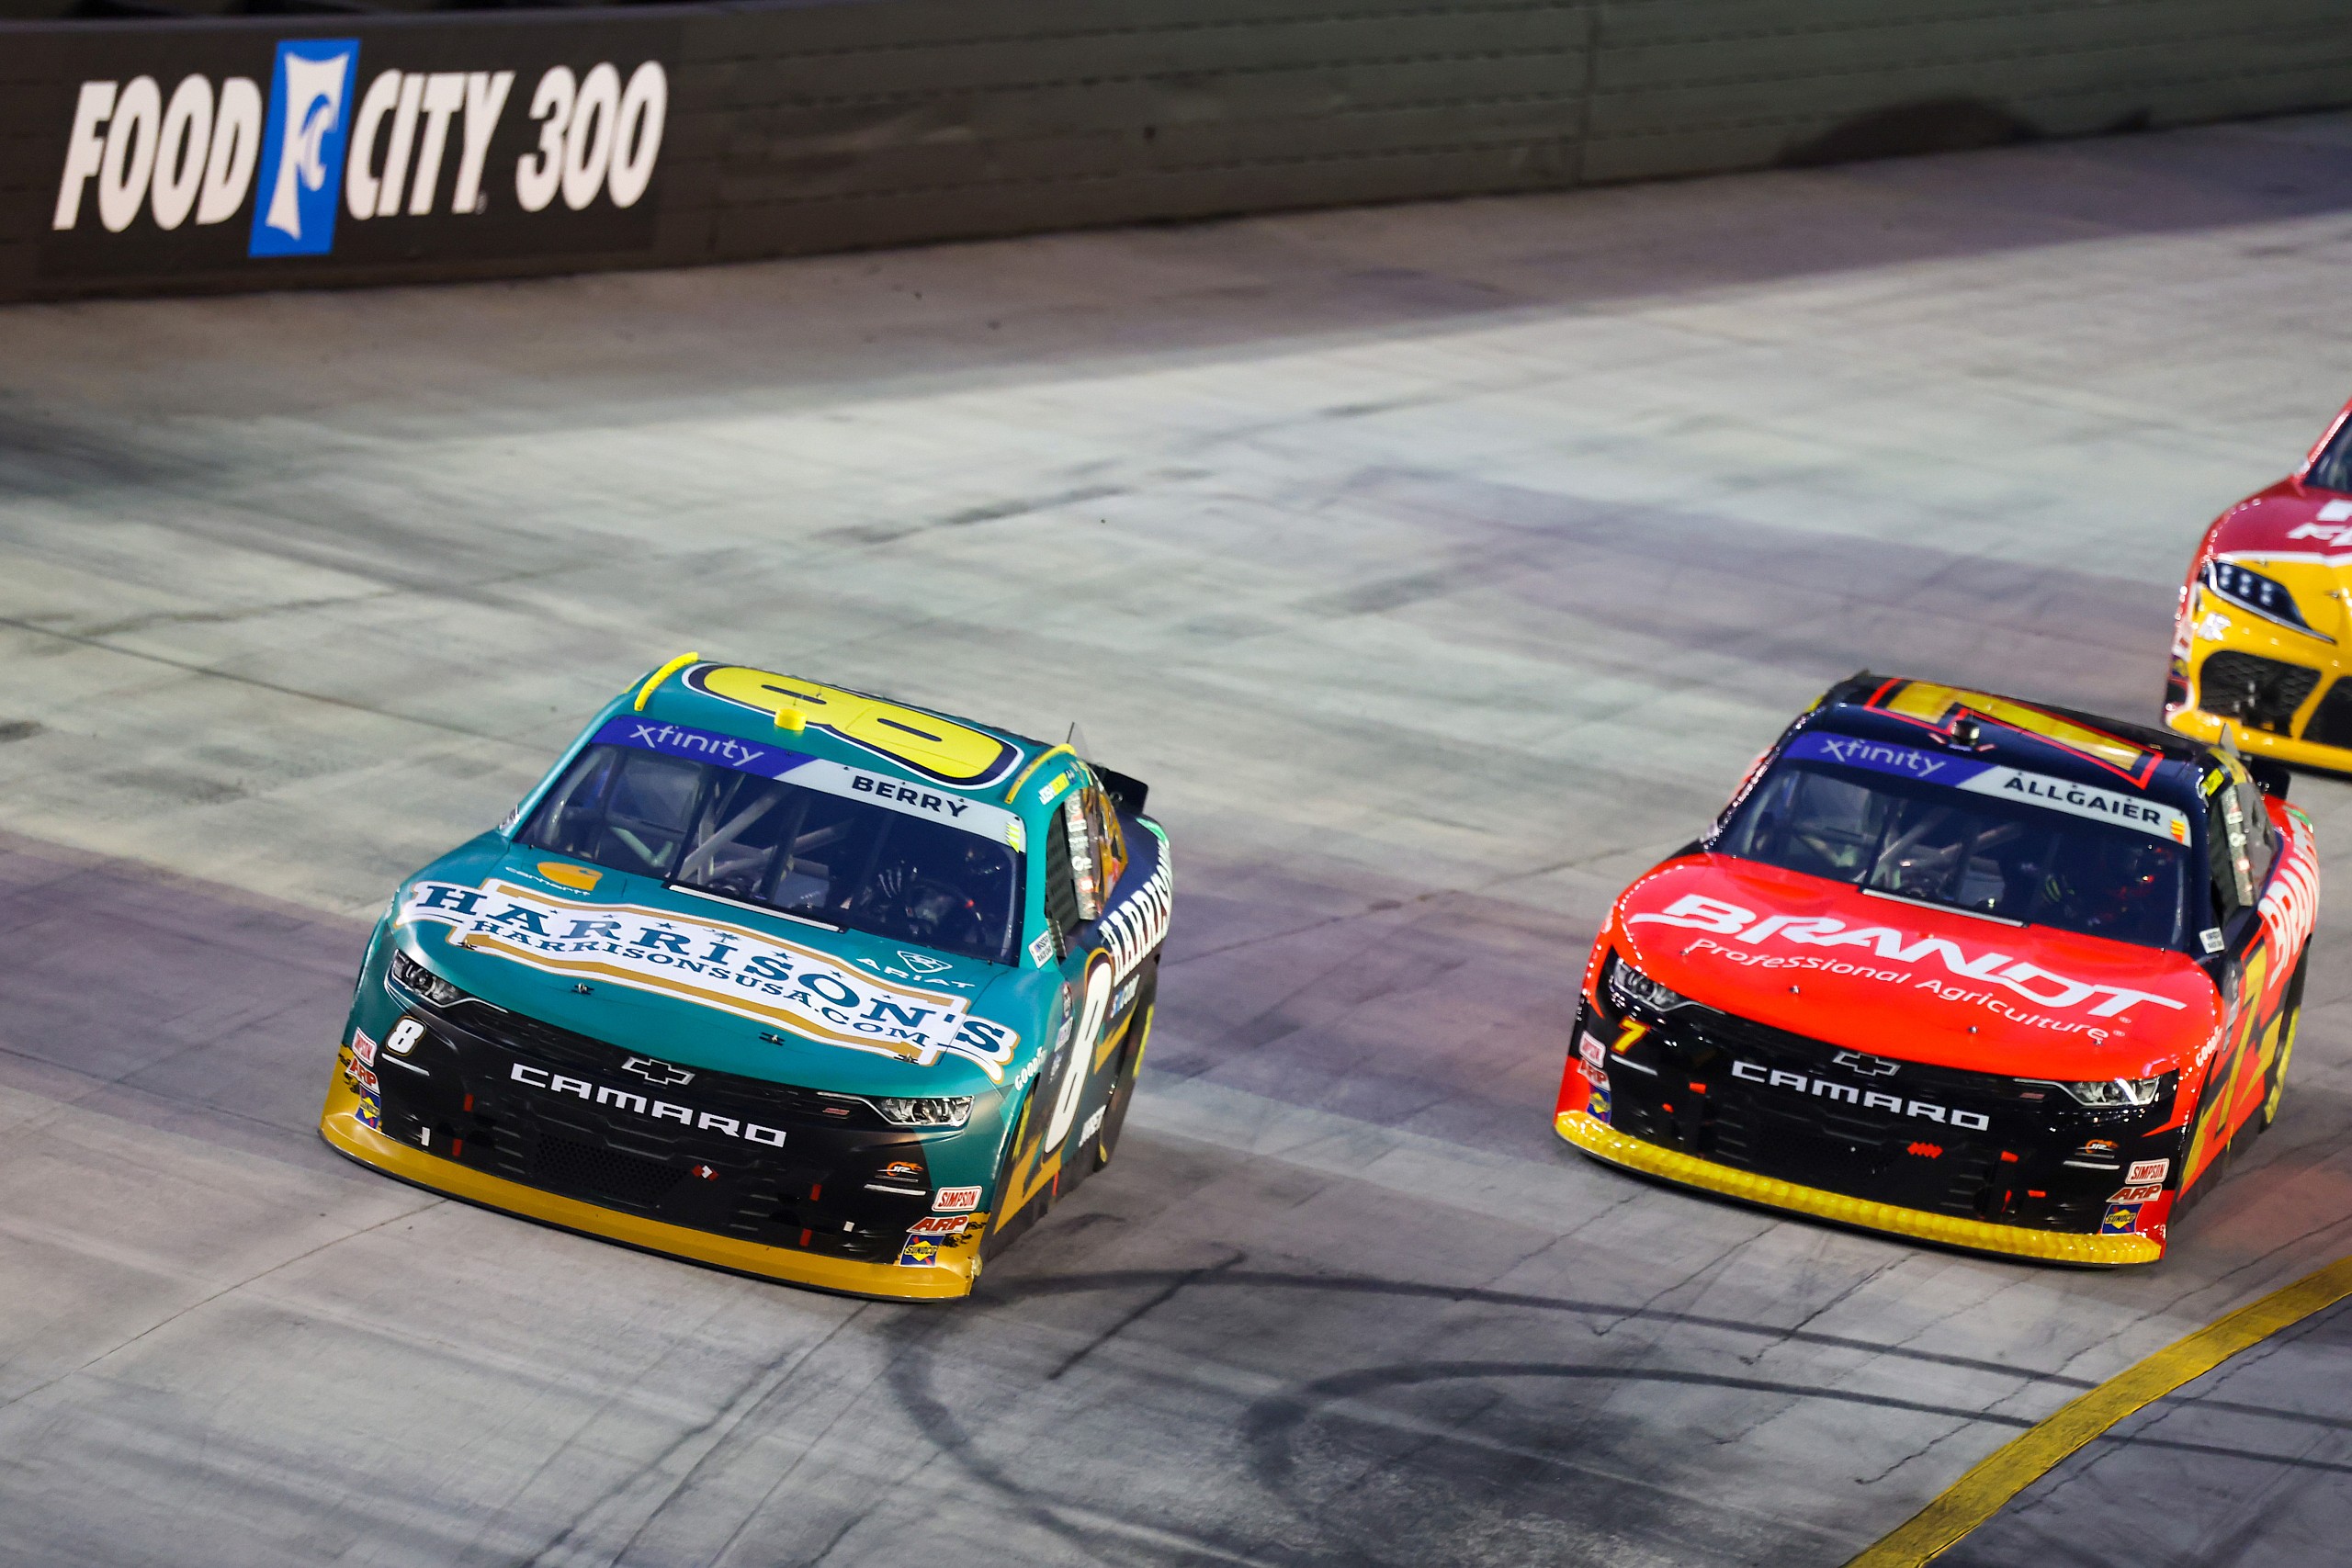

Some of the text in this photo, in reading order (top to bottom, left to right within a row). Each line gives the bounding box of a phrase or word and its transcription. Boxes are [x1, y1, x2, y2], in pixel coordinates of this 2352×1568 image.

[52, 74, 263, 232] FOOD
[346, 69, 515, 220] CITY
[515, 61, 668, 212] 300
[629, 723, 764, 767] xfinity
[684, 663, 1020, 787] 8
[1820, 739, 1946, 776] xfinity
[852, 775, 969, 818] BERRY
[2004, 776, 2162, 826] ALLGAIER
[416, 885, 1006, 1055] HARRISON'S
[855, 958, 976, 989] ARIAT
[1629, 894, 2188, 1017] BRANDT
[469, 920, 932, 1047] HARRISONSUSA.COM
[1686, 939, 2109, 1041] Professional Agriculture
[386, 1018, 426, 1054] 8
[1612, 1016, 1650, 1055] 7
[349, 1056, 377, 1087] ARP
[1044, 962, 1113, 1154] 8
[511, 1062, 787, 1148] CAMARO
[1731, 1060, 1990, 1132] CAMARO
[2111, 1184, 2162, 1201] ARP
[2130, 1162, 2166, 1180] SIMPSON
[937, 1190, 978, 1207] SIMPSON
[2105, 1212, 2136, 1224] SUNOCO
[912, 1215, 968, 1232] ARP
[905, 1245, 938, 1256] SUNOCO
